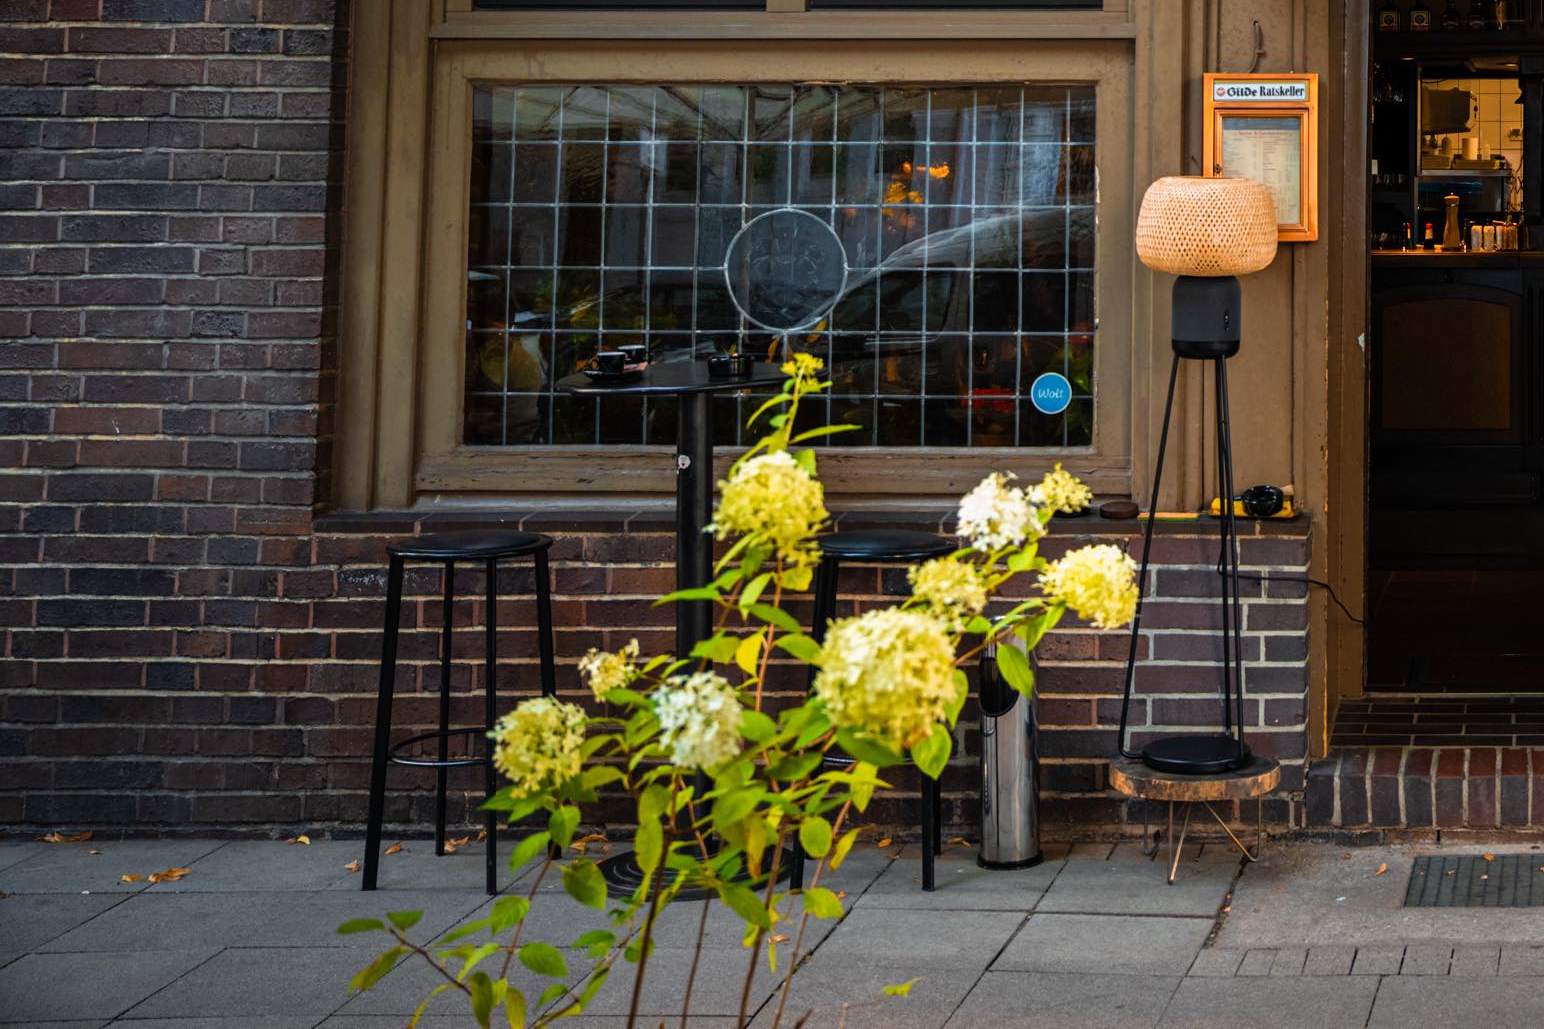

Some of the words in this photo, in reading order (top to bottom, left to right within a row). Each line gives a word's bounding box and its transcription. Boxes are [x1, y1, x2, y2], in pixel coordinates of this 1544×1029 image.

[1227, 87, 1257, 97] Gilde
[1260, 86, 1305, 97] Ratskeller
[1038, 388, 1065, 399] Wolt
